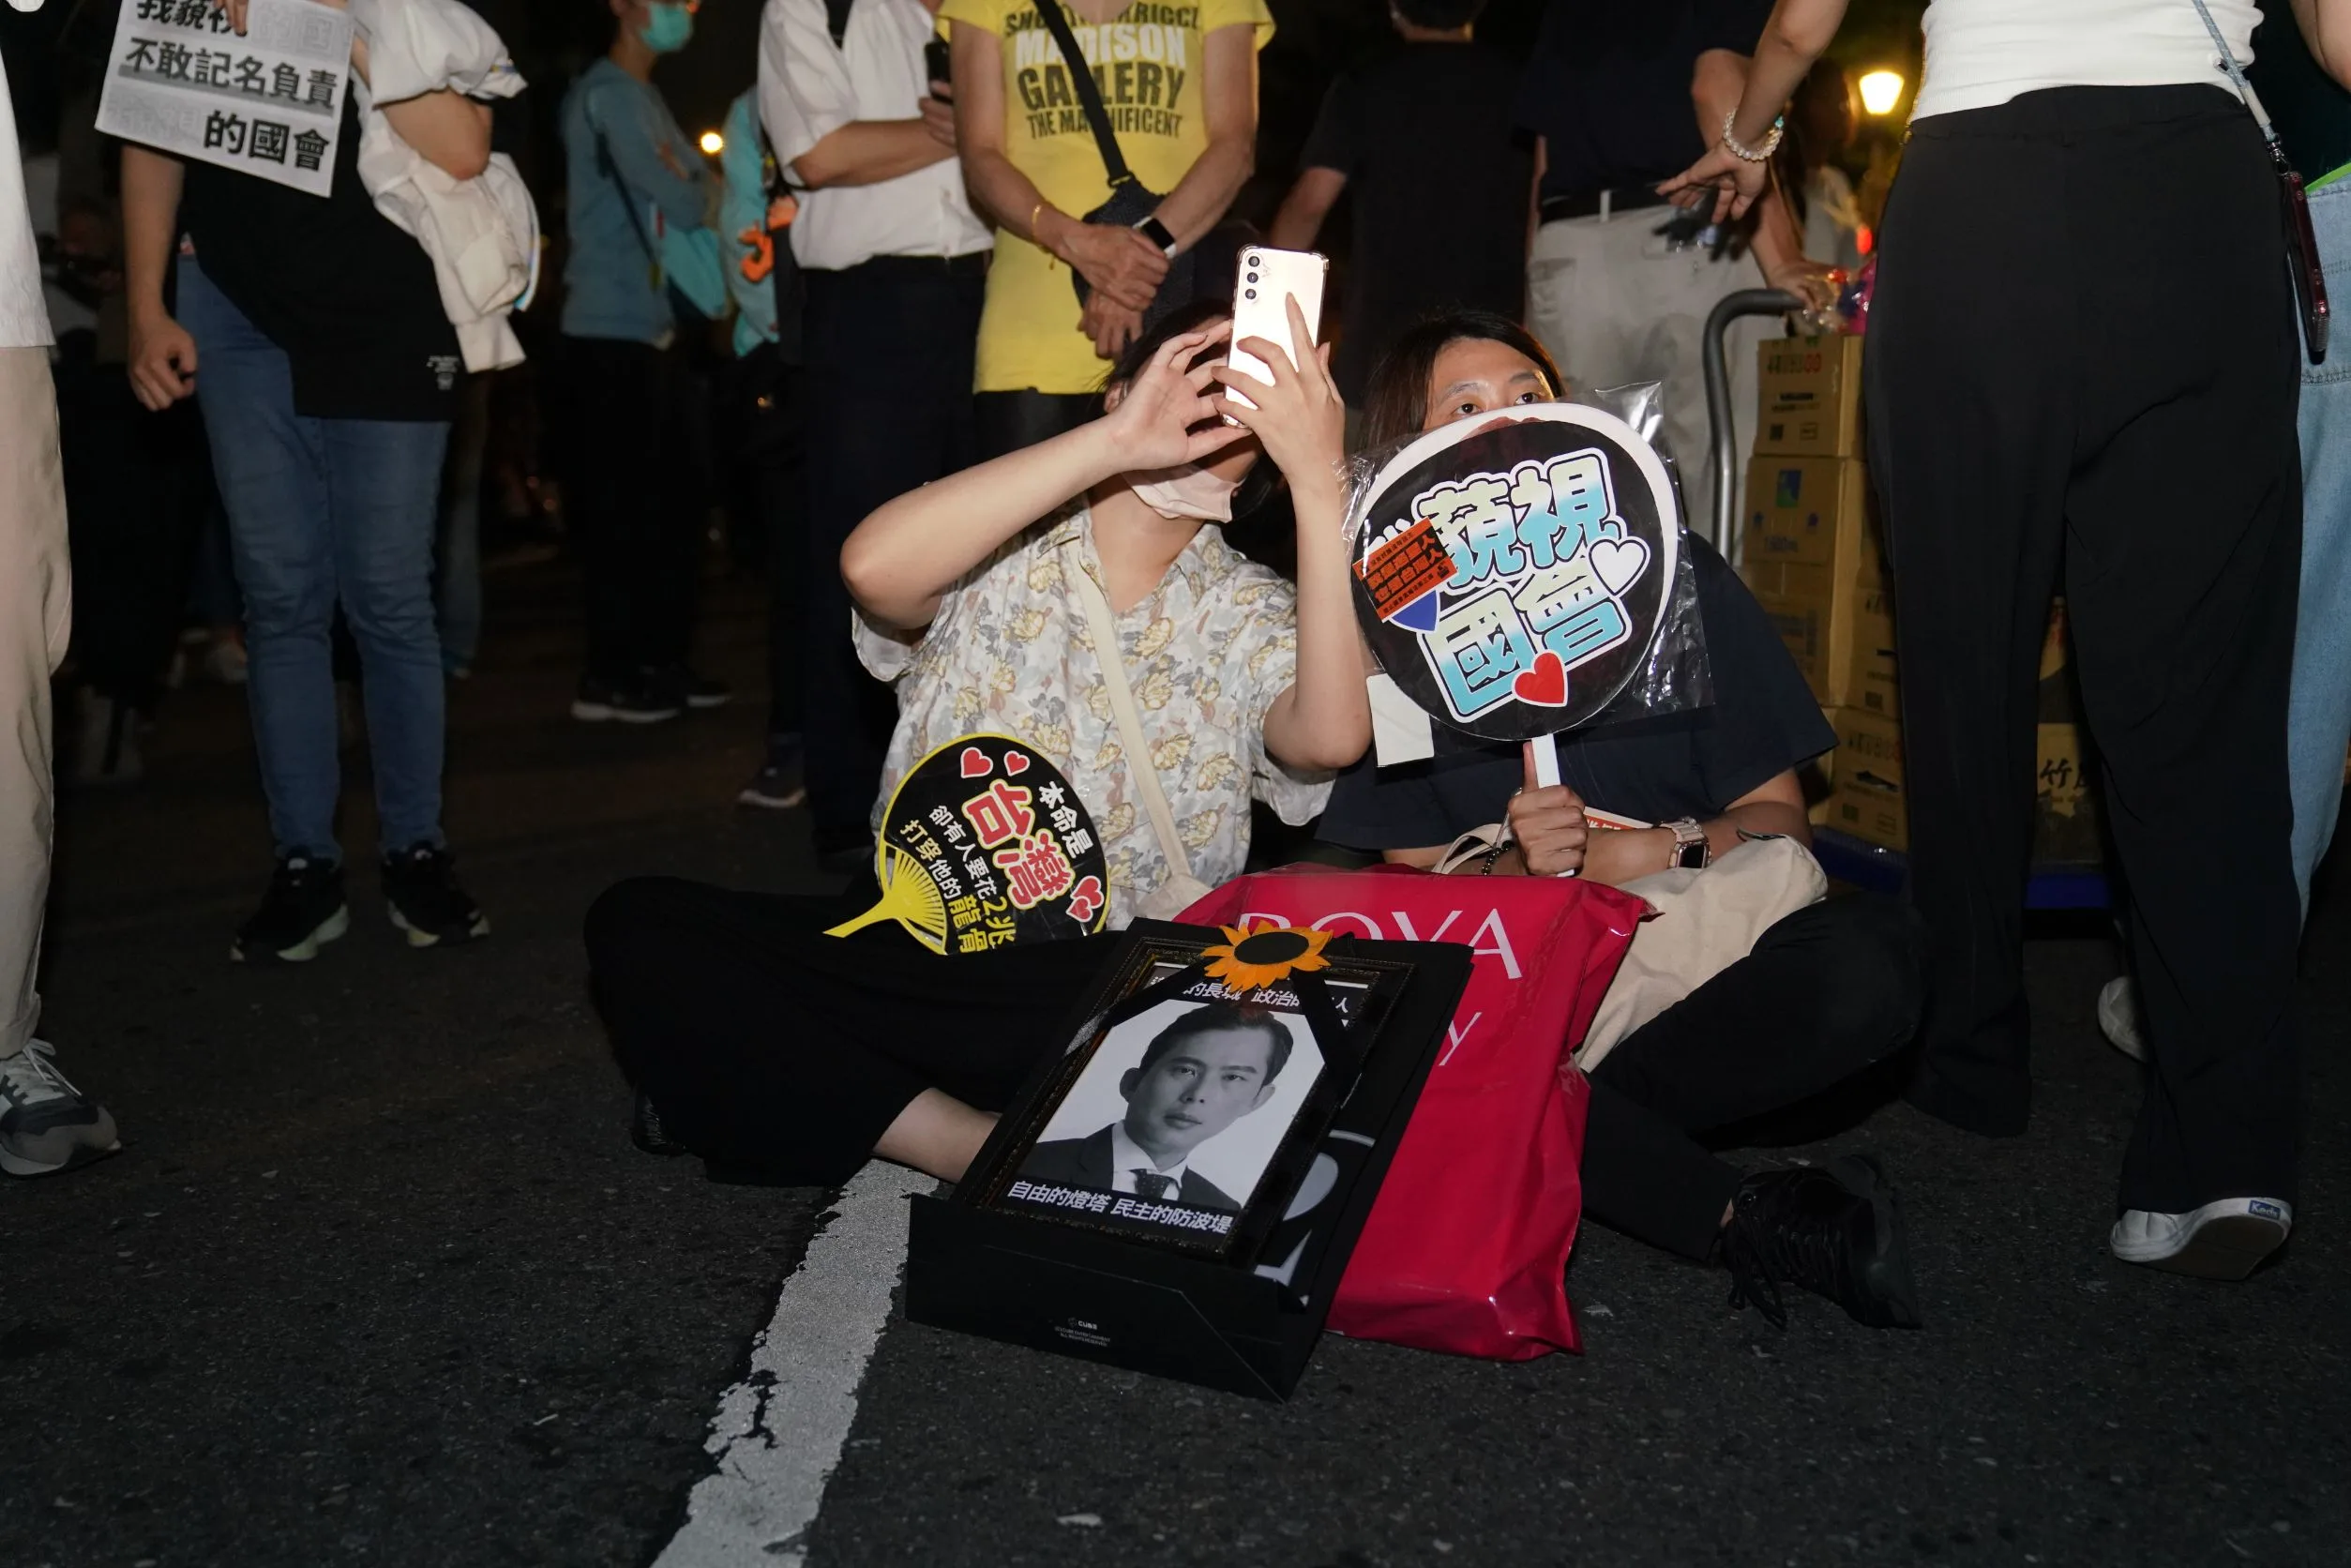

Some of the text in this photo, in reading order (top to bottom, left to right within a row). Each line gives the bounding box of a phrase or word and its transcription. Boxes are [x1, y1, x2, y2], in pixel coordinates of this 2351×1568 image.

[126, 37, 338, 110] 不敢記名負責
[1016, 23, 1186, 71] MADISON
[1017, 62, 1185, 112] GALERY
[1026, 108, 1183, 139] THE MANIFICENT
[203, 110, 330, 172] 的國會
[1417, 551, 1632, 723] 國會
[962, 778, 1077, 910] 台灣
[1038, 781, 1093, 859] 本命是
[899, 819, 988, 954] 打穿他的龍骨
[928, 805, 1017, 949] 卻有人要花2兆
[1007, 1181, 1233, 1234] 自由的燈塔 民主的防波堤
